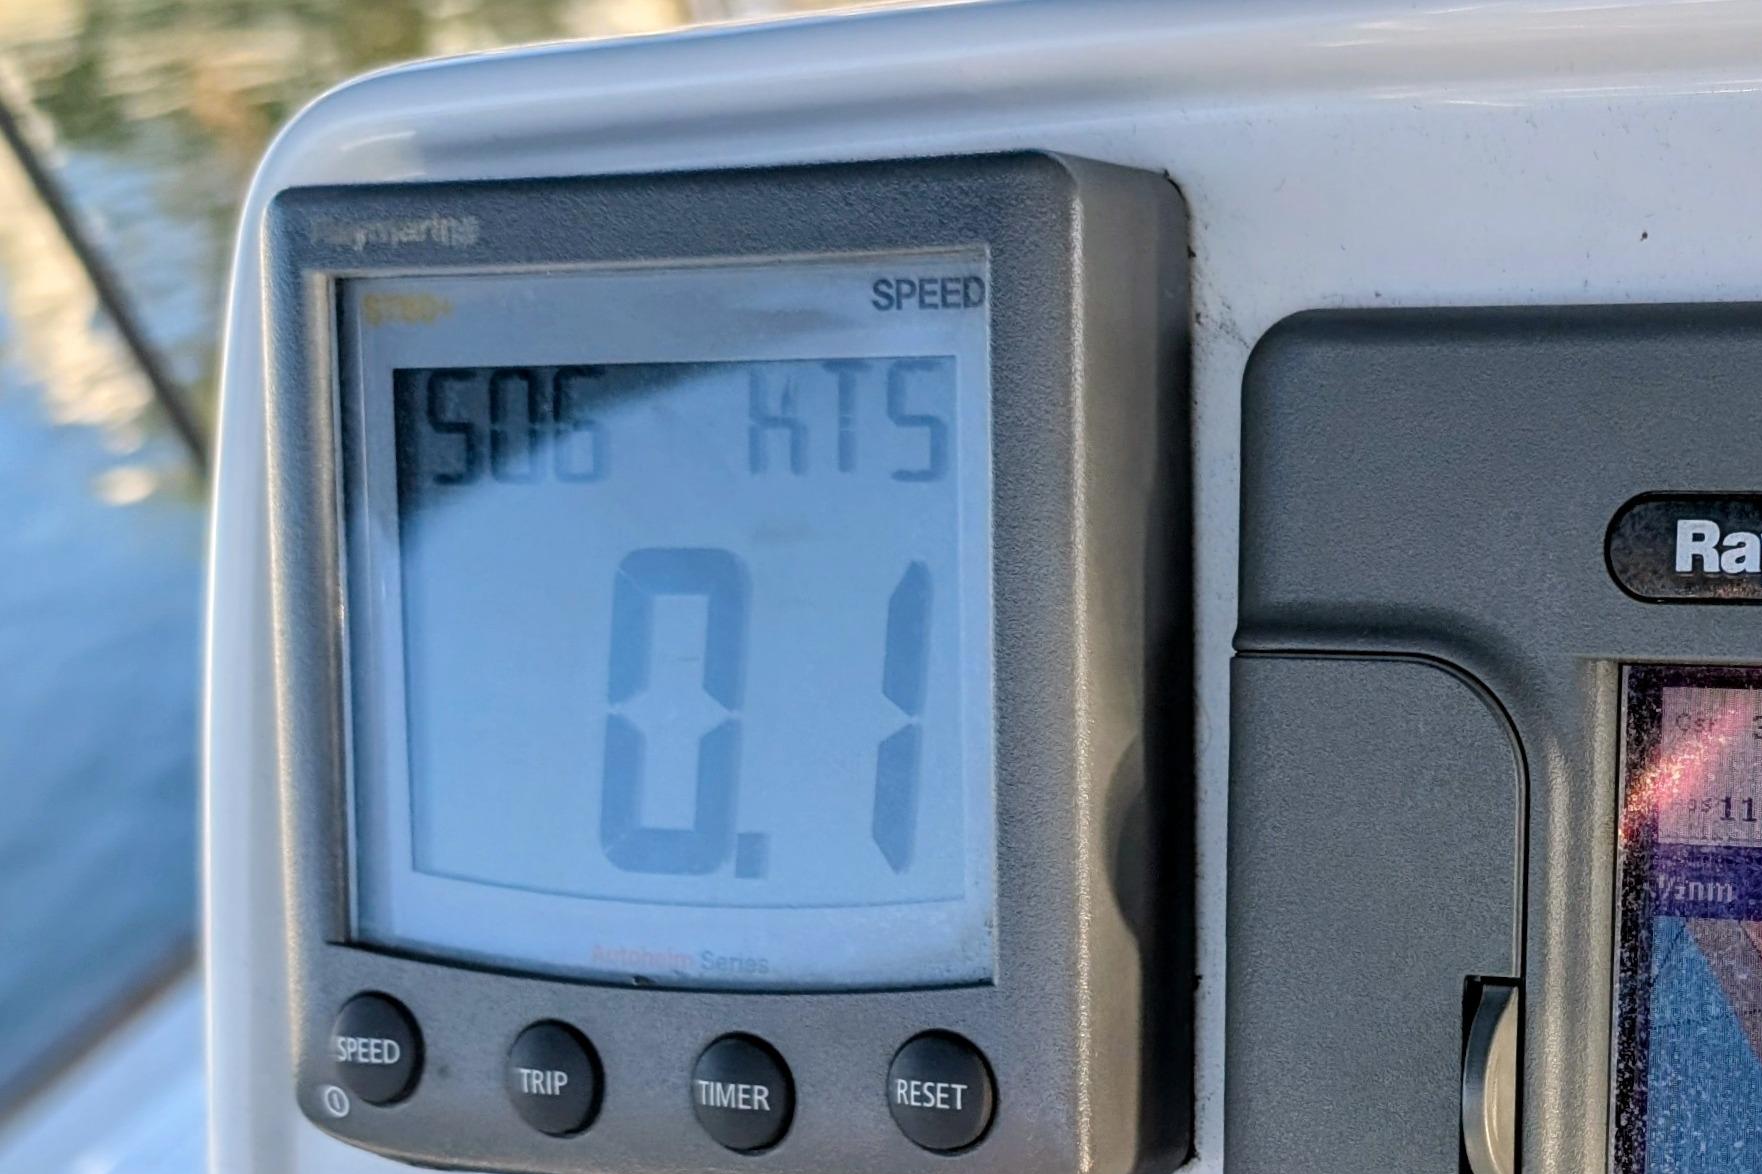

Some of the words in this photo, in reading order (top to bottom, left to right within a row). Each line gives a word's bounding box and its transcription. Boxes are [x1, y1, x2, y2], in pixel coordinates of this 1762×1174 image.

[872, 276, 985, 314] SPEED
[746, 357, 952, 484] KTS
[600, 546, 932, 880] 0.1
[337, 1035, 400, 1065] SPEED
[520, 1067, 569, 1096] TRIP
[698, 1080, 771, 1111] TIMER
[896, 1079, 969, 1110] RESET
